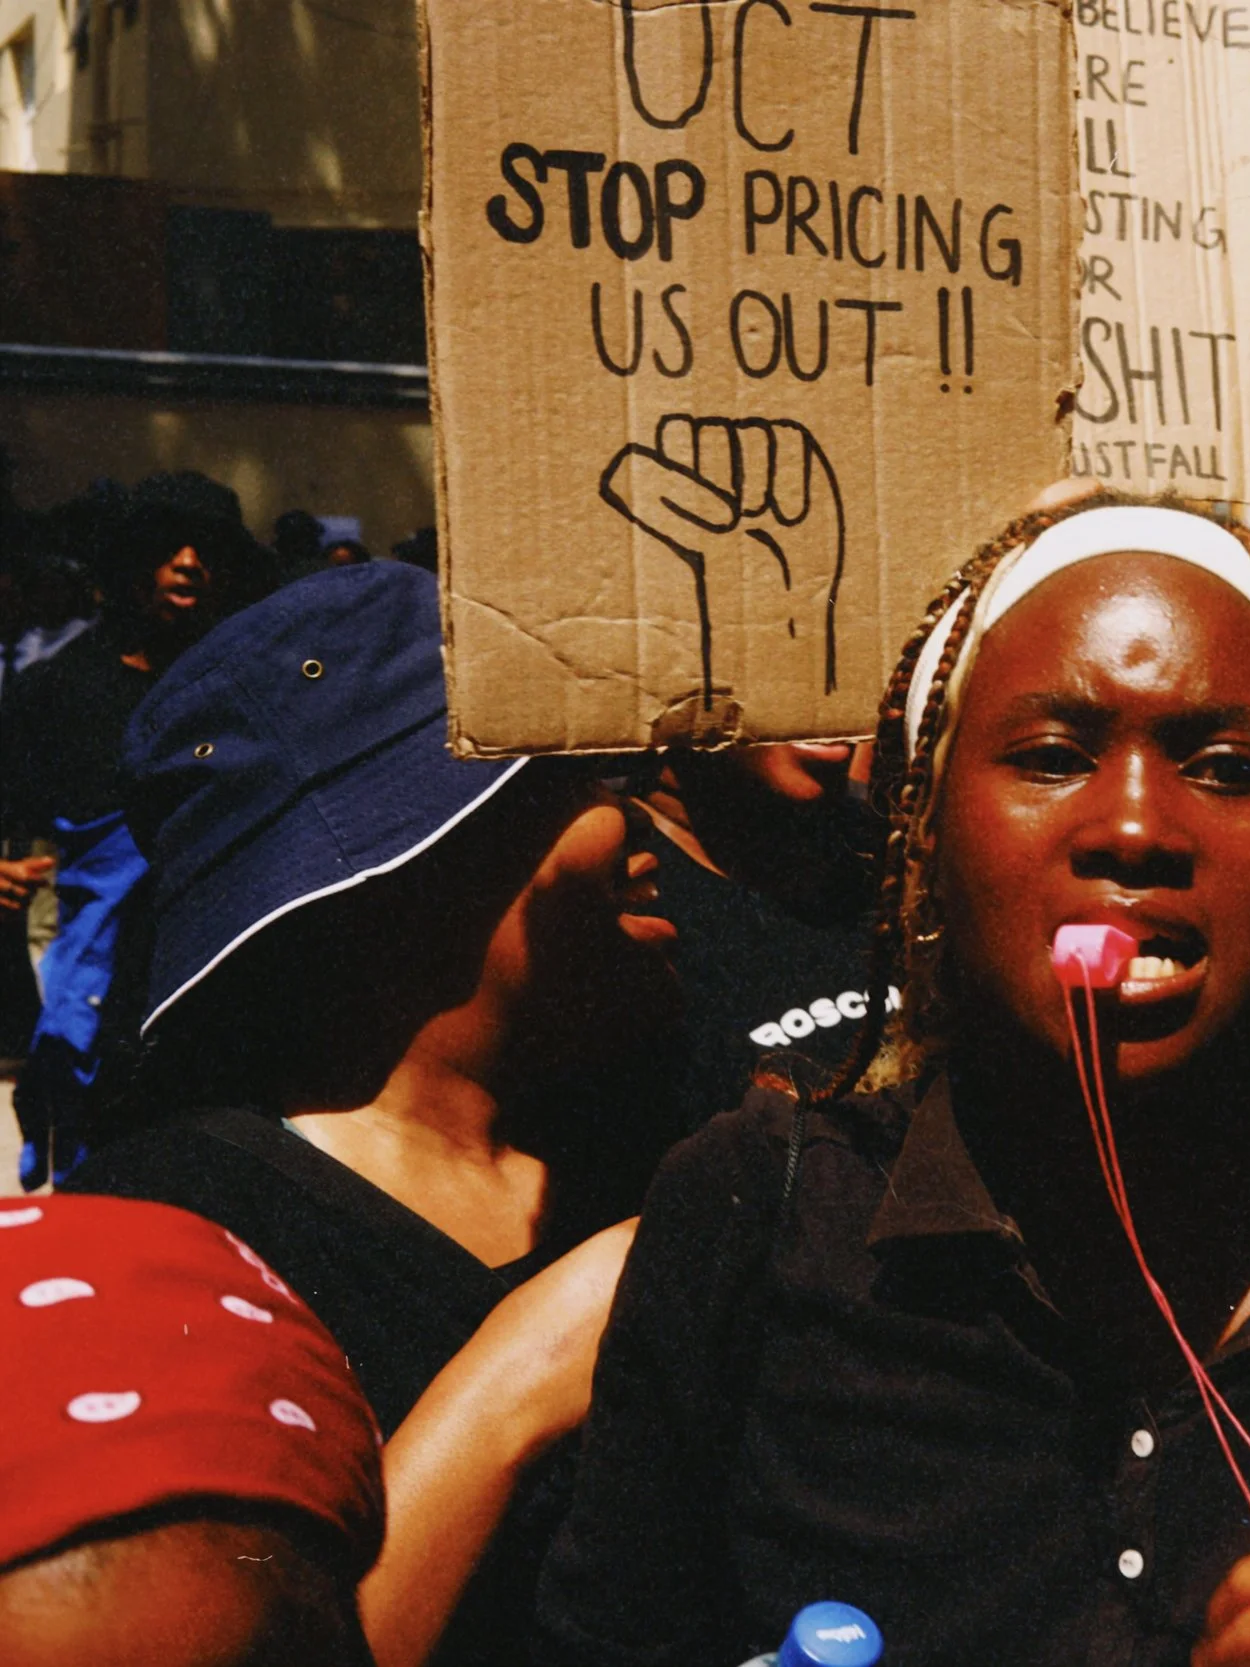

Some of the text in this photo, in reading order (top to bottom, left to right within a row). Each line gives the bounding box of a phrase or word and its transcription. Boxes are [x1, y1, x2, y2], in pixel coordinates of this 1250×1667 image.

[622, 0, 917, 155] UCT
[1085, 54, 1148, 107] RE
[1084, 116, 1134, 178] LL
[486, 142, 1023, 287] STOP PRICING
[1083, 189, 1228, 254] STING
[591, 281, 694, 378] US
